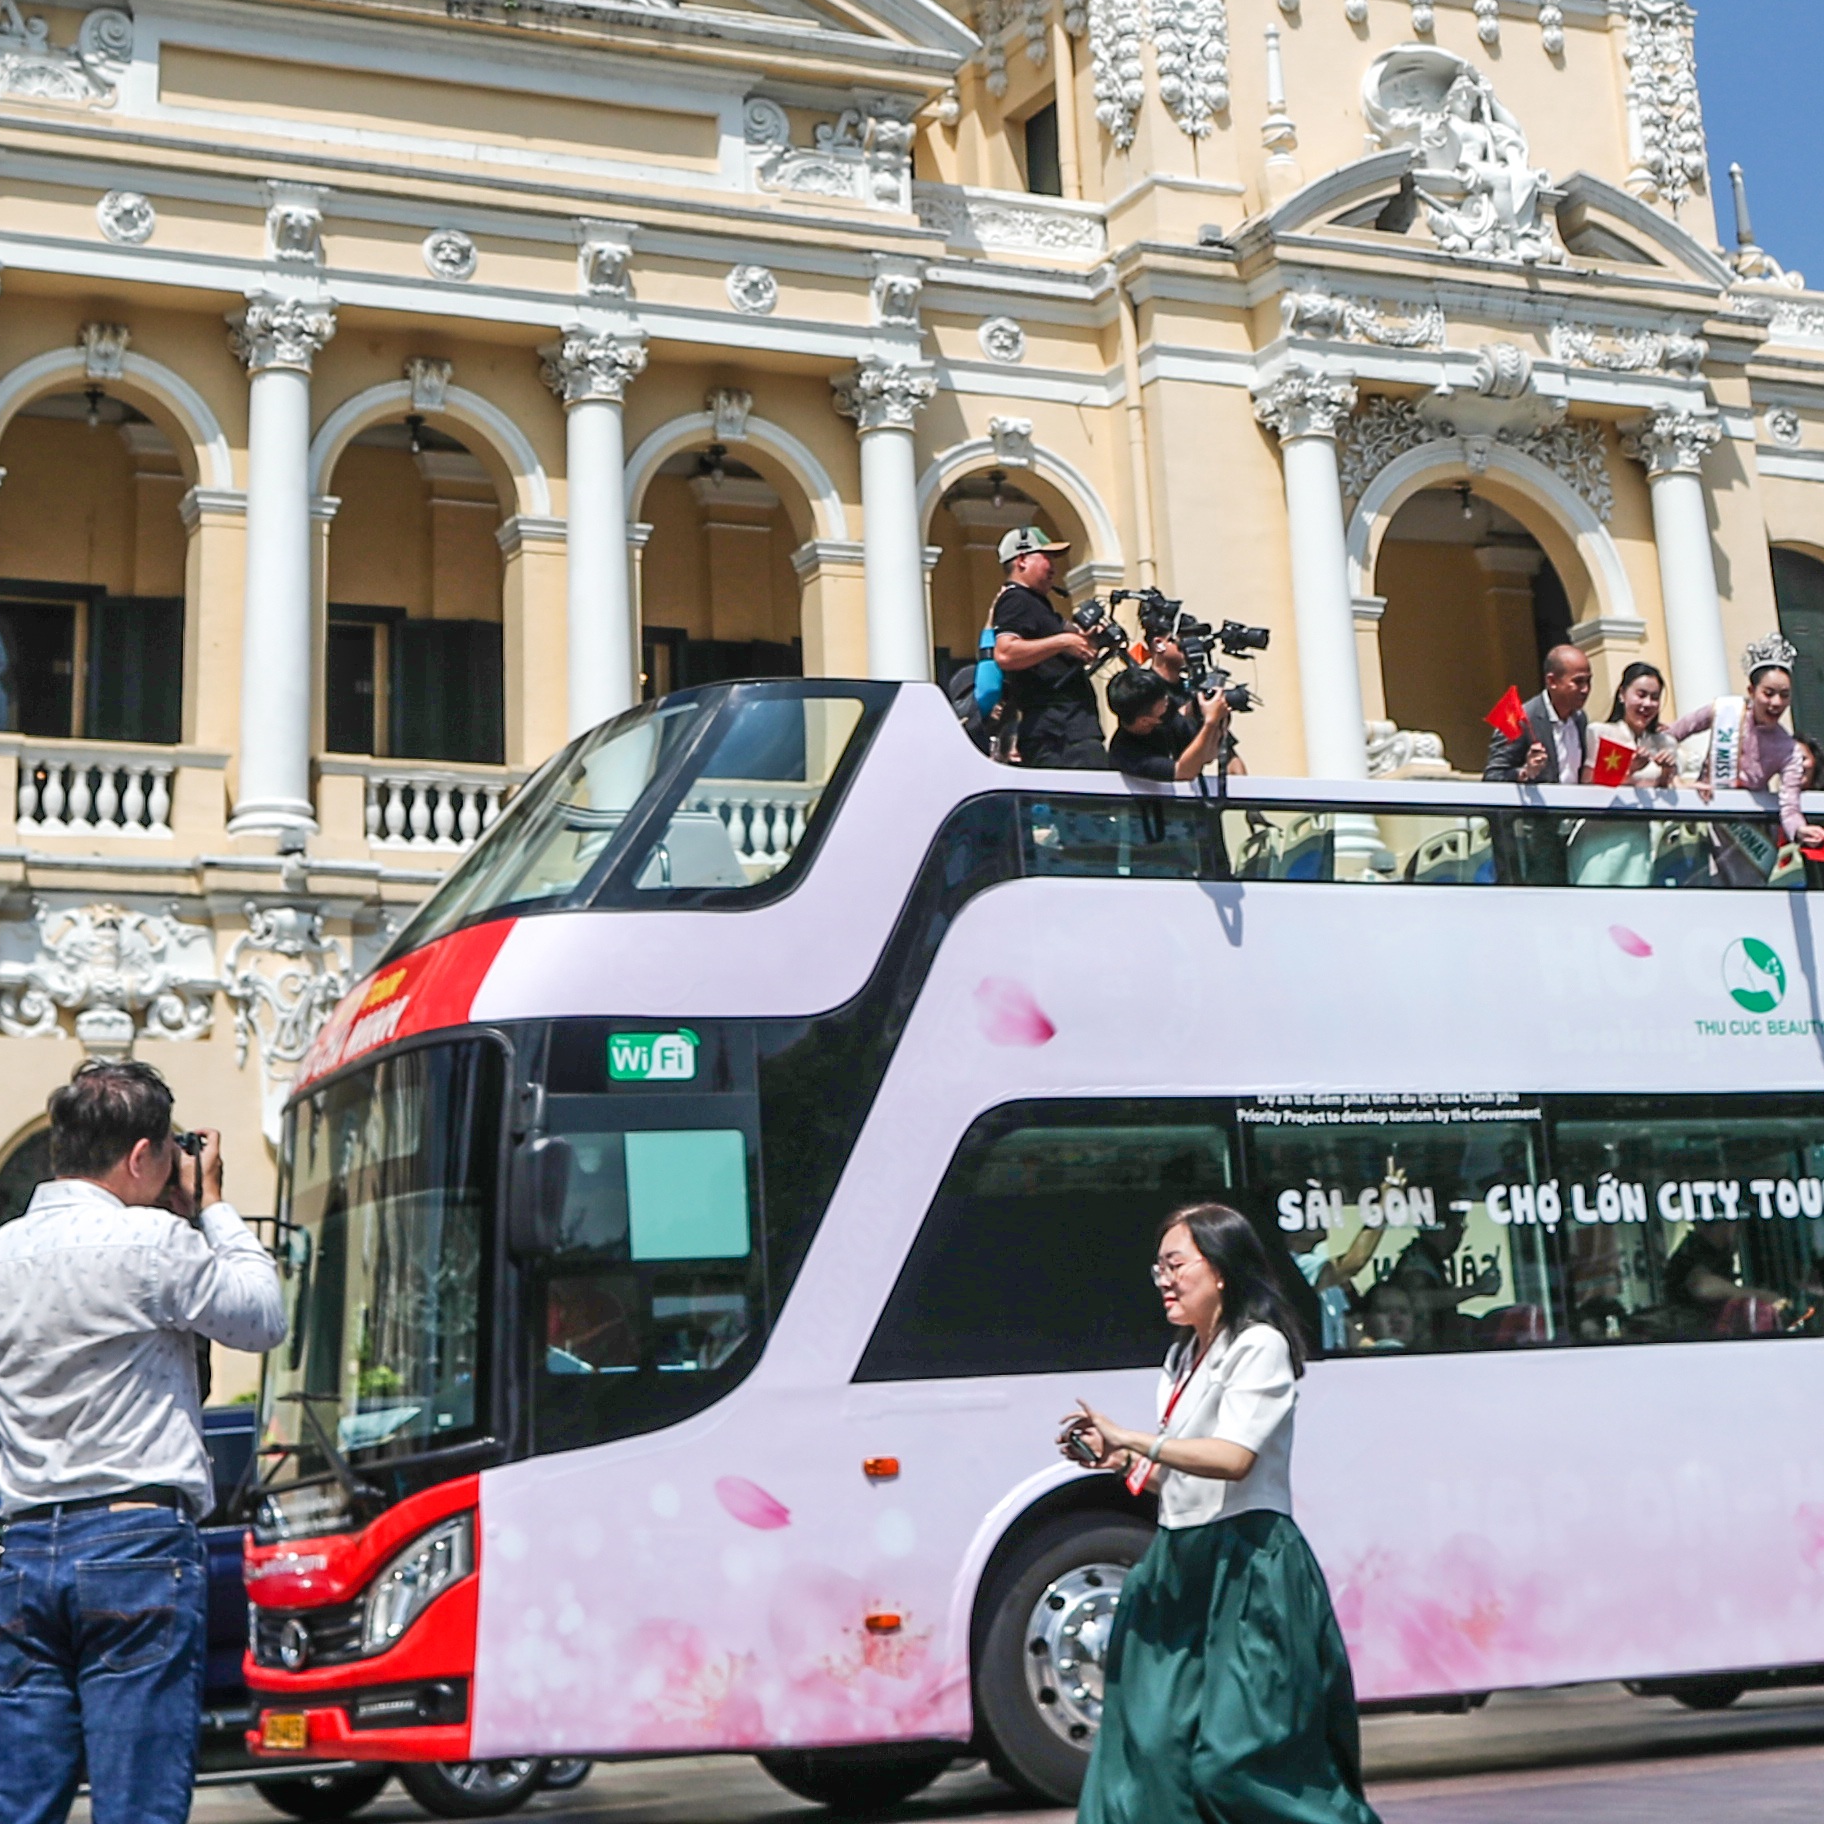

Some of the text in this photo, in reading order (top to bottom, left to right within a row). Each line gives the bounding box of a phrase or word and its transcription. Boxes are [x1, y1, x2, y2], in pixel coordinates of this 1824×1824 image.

[1695, 1020, 1726, 1036] THU
[1237, 1107, 1541, 1126] Priority Project to develop tourism by the Government
[1277, 1178, 1344, 1231] SÀI
[1358, 1176, 1437, 1229] GÒN
[1485, 1178, 1562, 1234] CHỢ
[1571, 1172, 1648, 1224] LỚN
[1657, 1179, 1741, 1222] CITY
